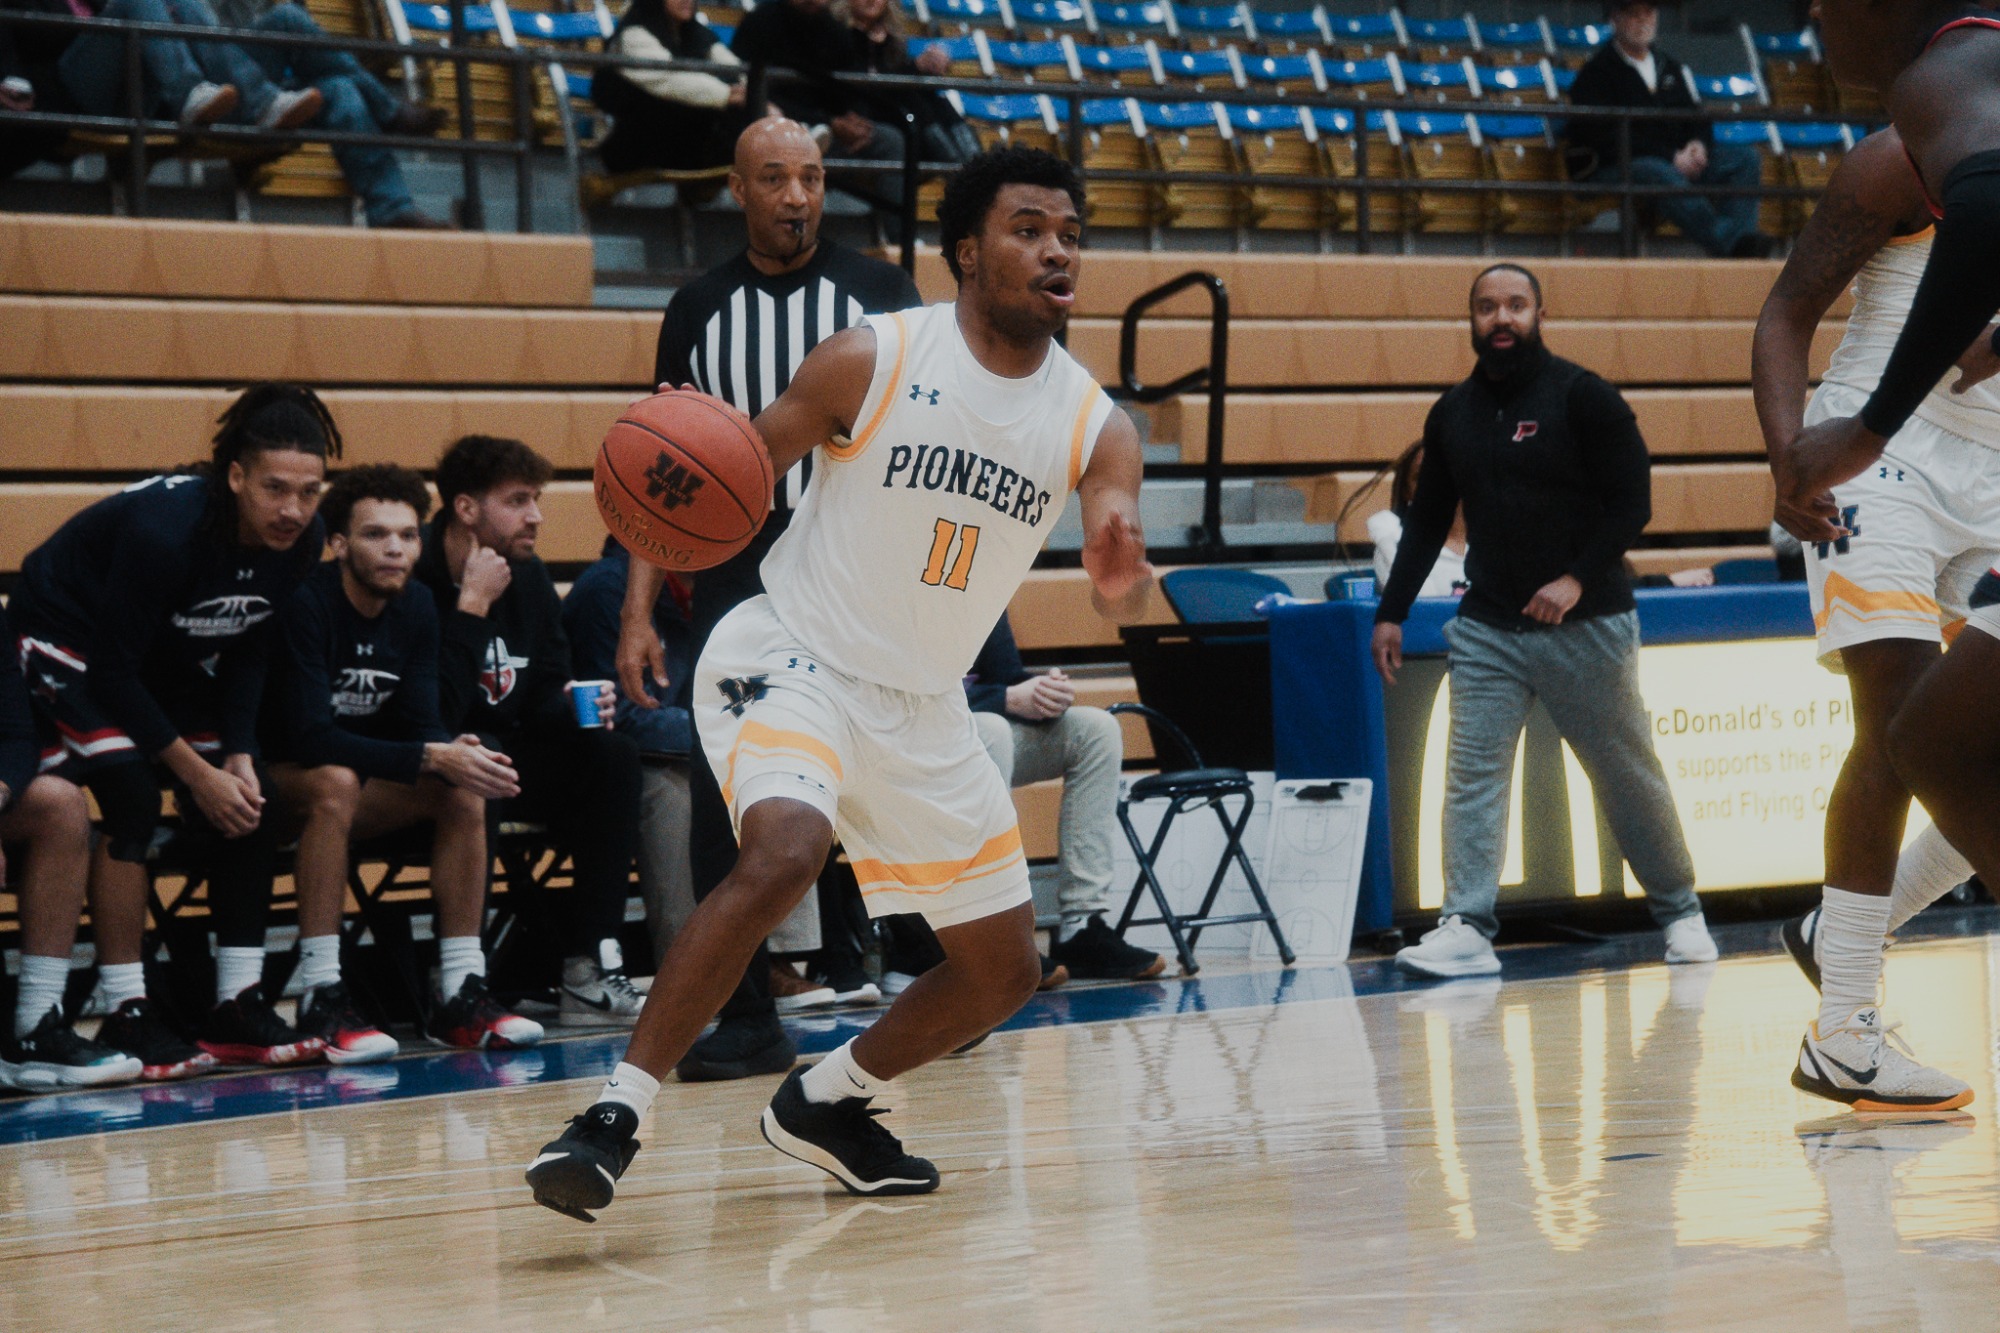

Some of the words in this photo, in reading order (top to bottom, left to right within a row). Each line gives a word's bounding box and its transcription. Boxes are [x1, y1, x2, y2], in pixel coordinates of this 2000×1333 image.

[882, 443, 1051, 527] PIONEERS
[598, 480, 695, 565] SPALDING
[920, 517, 981, 592] 11
[1649, 703, 1782, 737] cDonald's
[1793, 701, 1817, 728] of
[1828, 699, 1852, 725] Pl
[1677, 751, 1771, 782] supports
[1779, 747, 1812, 772] the
[1694, 794, 1732, 821] and
[1740, 791, 1805, 823] Flying
